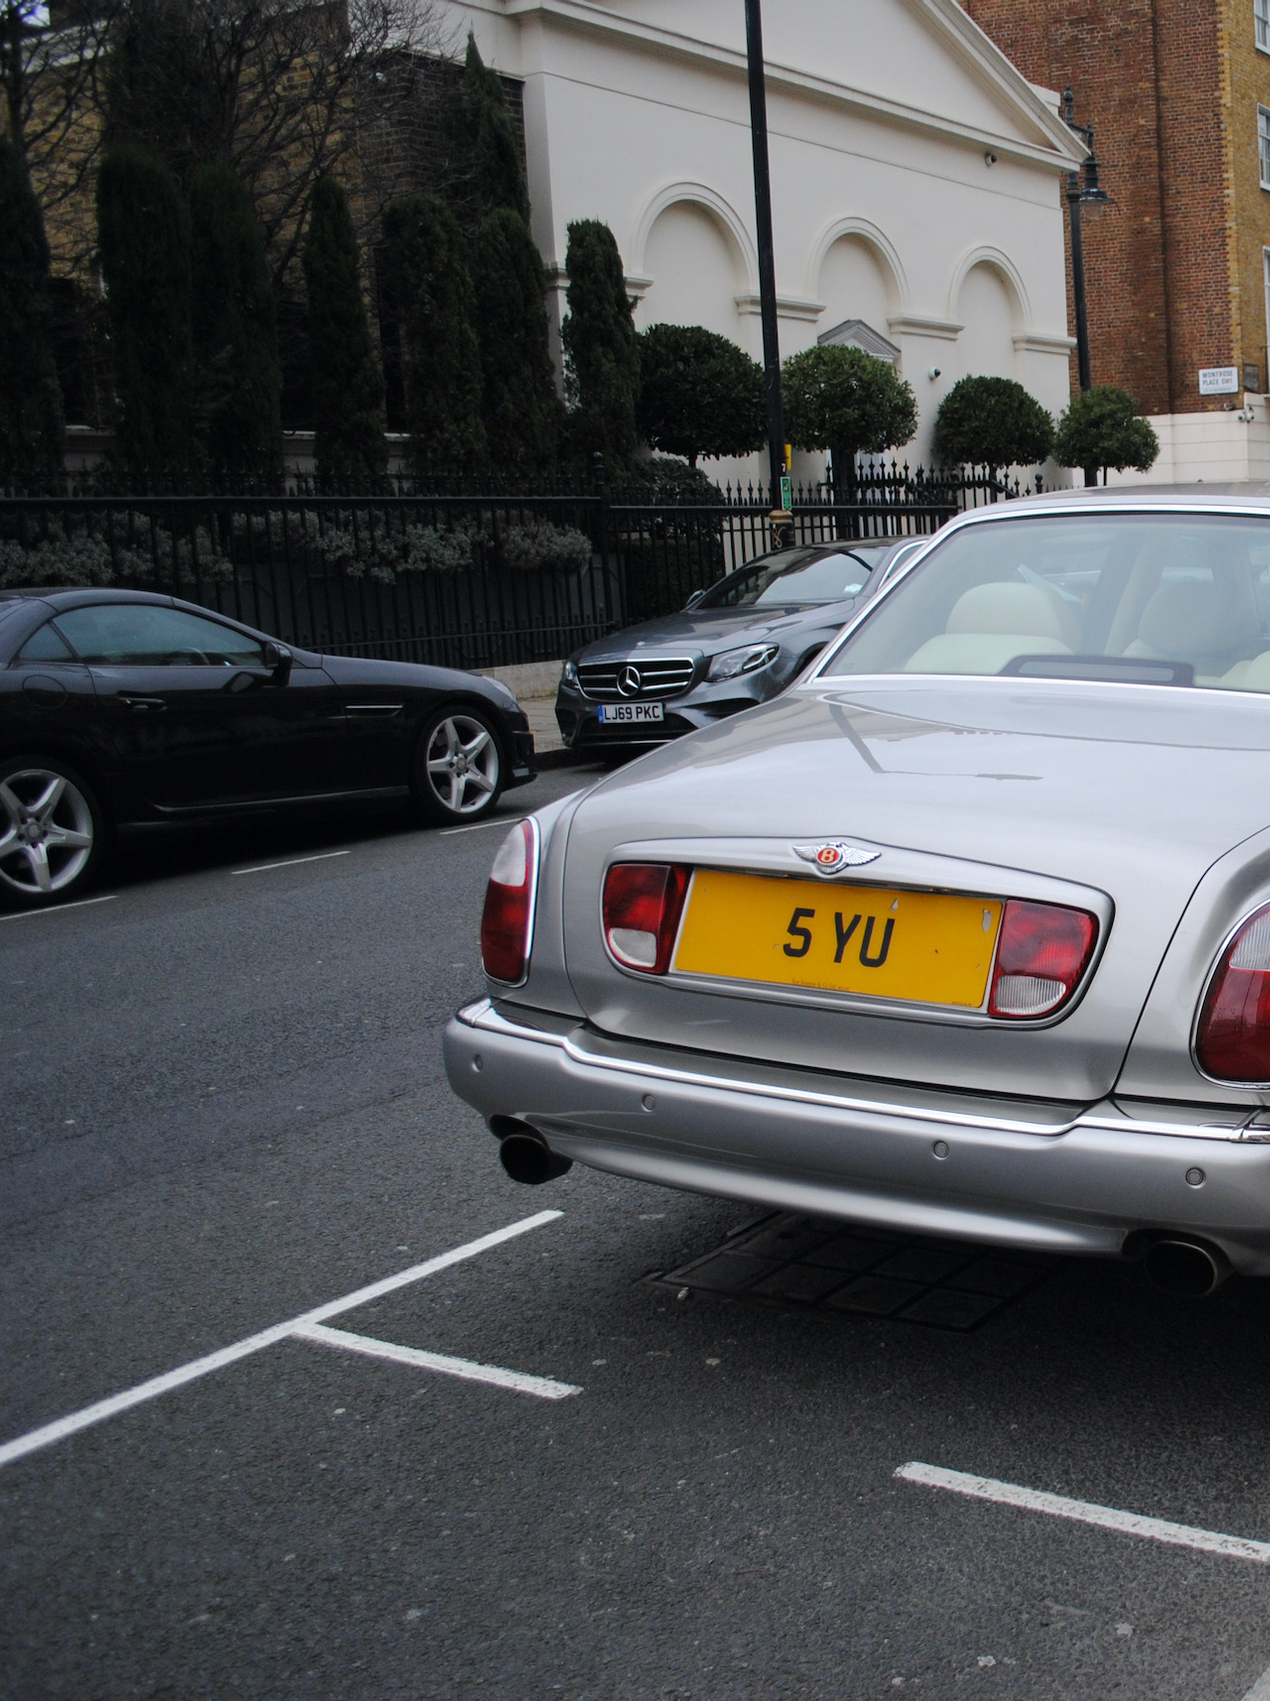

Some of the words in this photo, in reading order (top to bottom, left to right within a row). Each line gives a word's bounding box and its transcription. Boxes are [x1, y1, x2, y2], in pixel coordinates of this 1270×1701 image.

[1202, 370, 1233, 379] MONTROSE
[1202, 378, 1219, 386] PLACE
[1221, 377, 1233, 385] SW1
[781, 463, 786, 473] 7
[604, 707, 633, 720] LJ69
[635, 705, 660, 719] PKC
[821, 848, 835, 862] B
[783, 907, 815, 958] 5
[833, 912, 896, 968] YU
